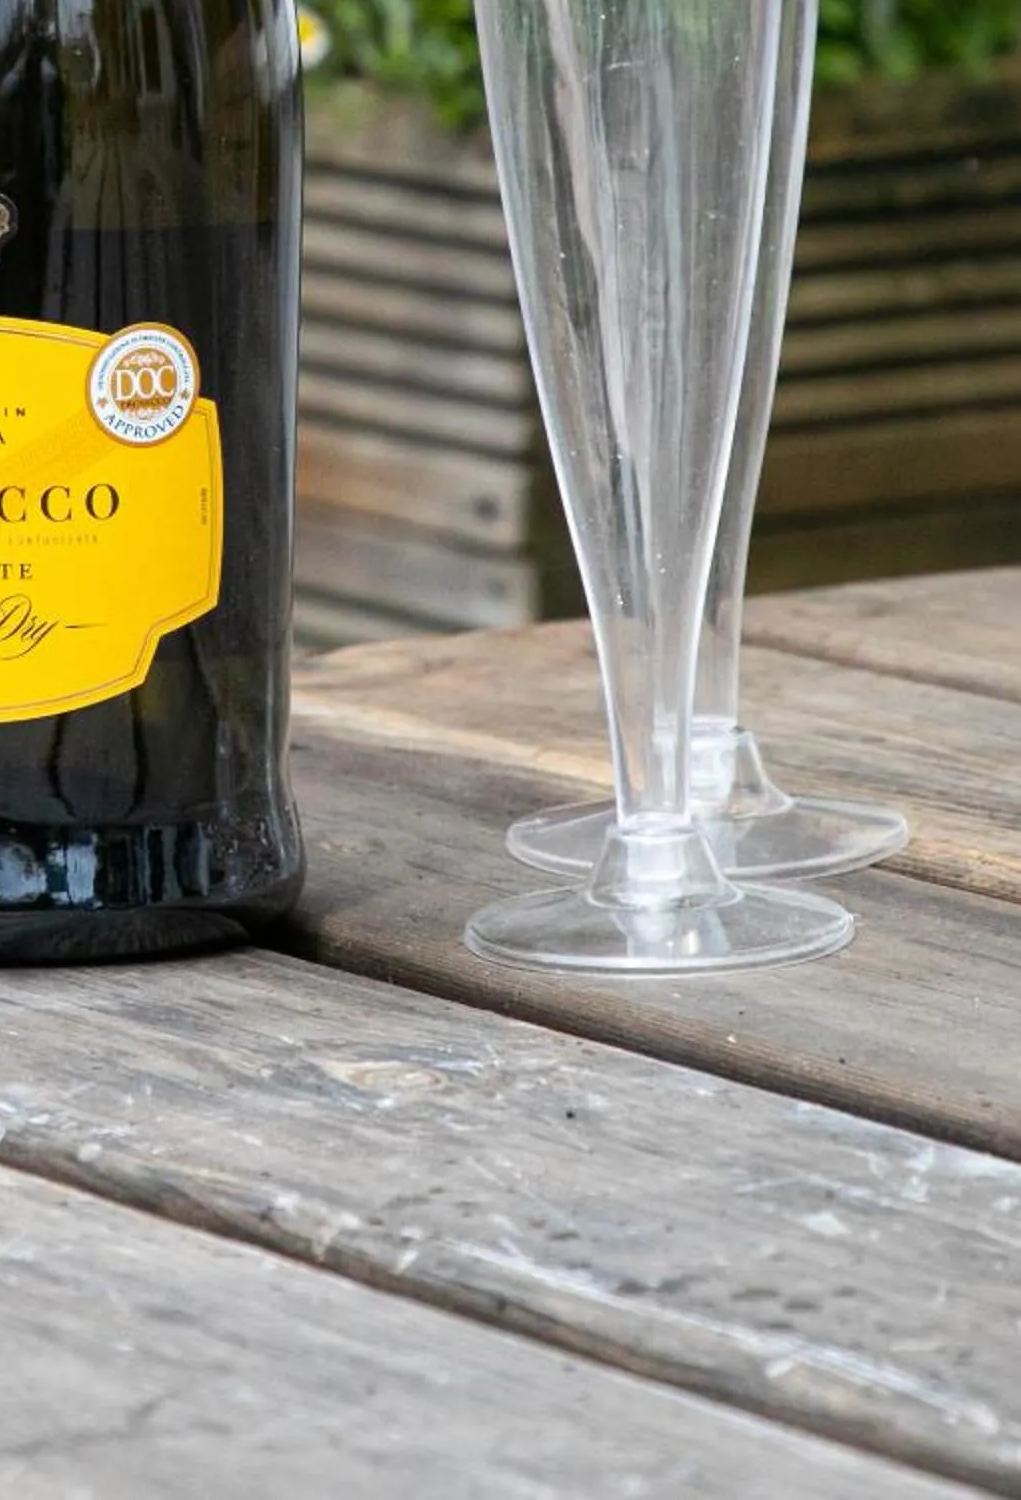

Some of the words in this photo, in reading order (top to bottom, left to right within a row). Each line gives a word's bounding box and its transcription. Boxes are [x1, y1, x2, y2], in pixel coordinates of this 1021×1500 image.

[116, 365, 175, 401] DOC
[4, 406, 26, 417] IN
[105, 404, 184, 439] APPROVED
